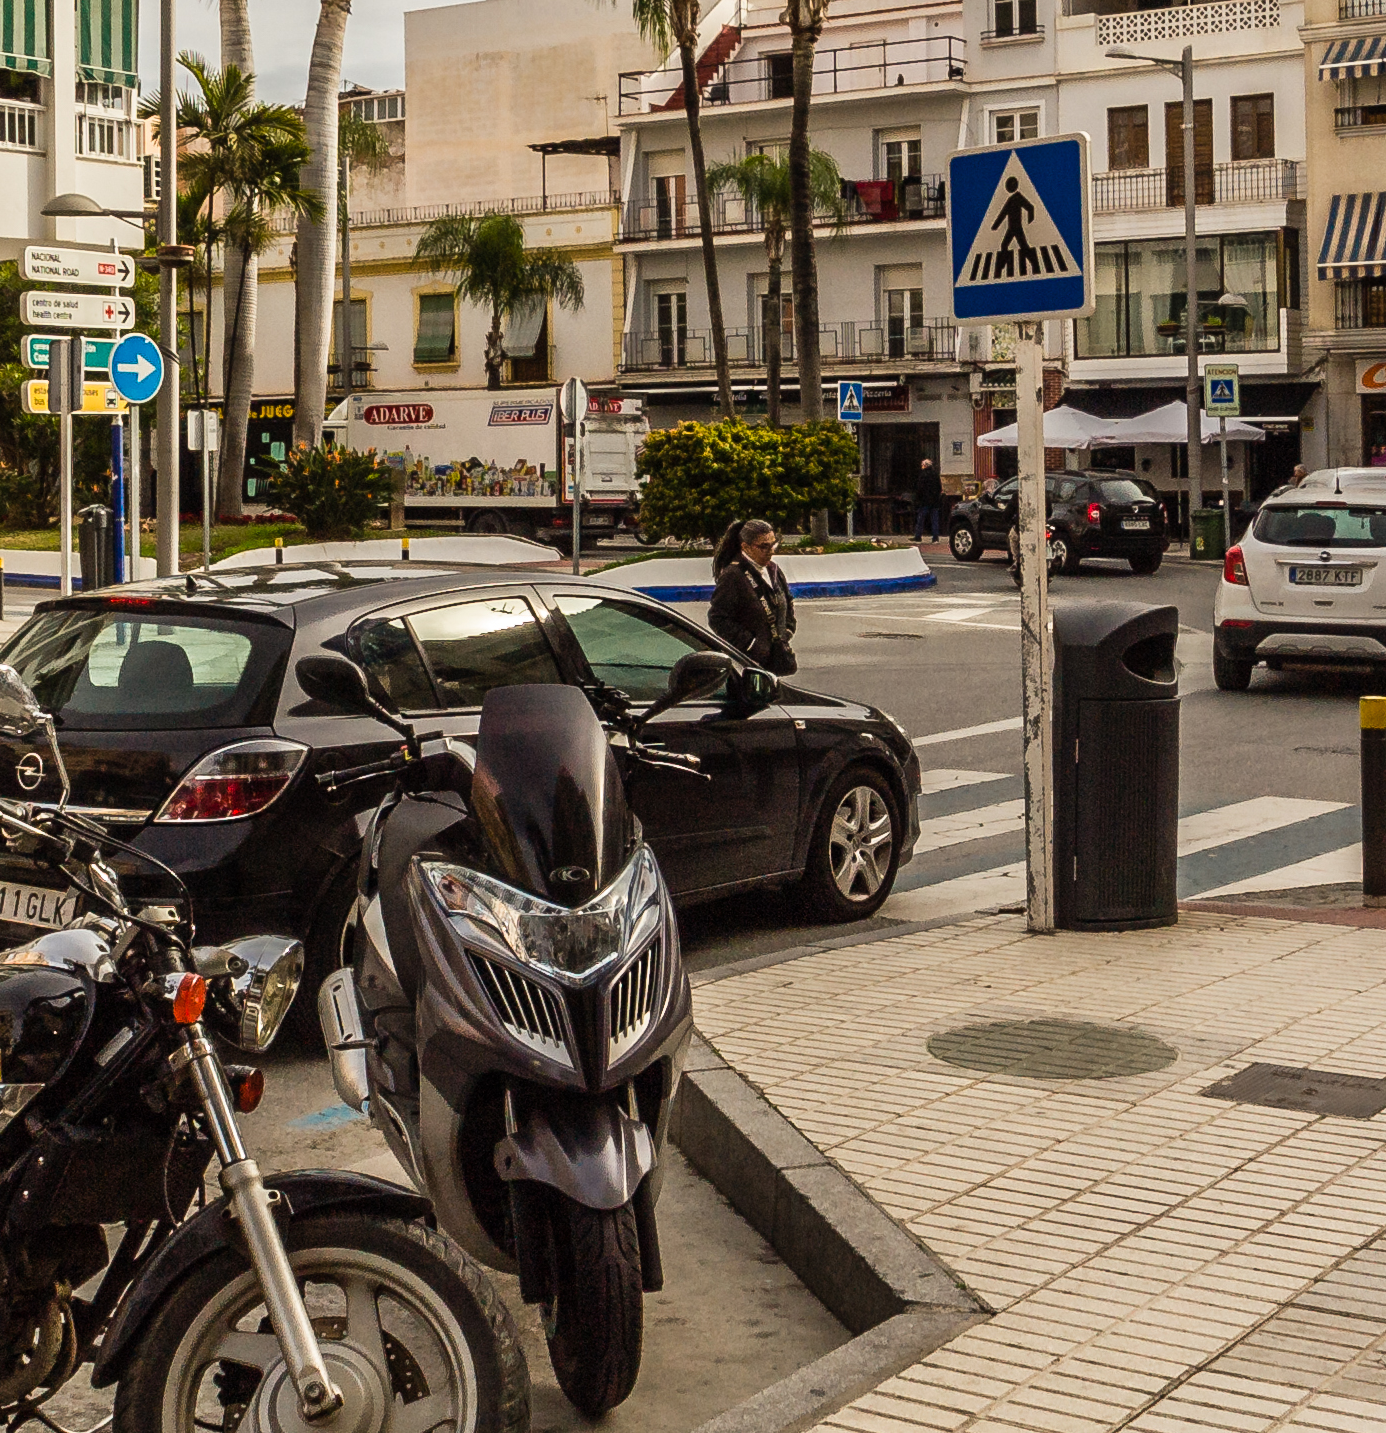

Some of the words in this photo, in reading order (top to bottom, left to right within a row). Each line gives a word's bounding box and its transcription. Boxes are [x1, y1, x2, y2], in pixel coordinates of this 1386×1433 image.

[31, 251, 61, 264] NACIONAL
[31, 265, 61, 276] NATIONAL
[62, 267, 80, 278] ROAD
[369, 406, 430, 423] ADARVE
[493, 410, 519, 422] IBER
[520, 409, 546, 421] PLUS
[1298, 569, 1331, 583] 2887
[1334, 570, 1357, 583] KTF
